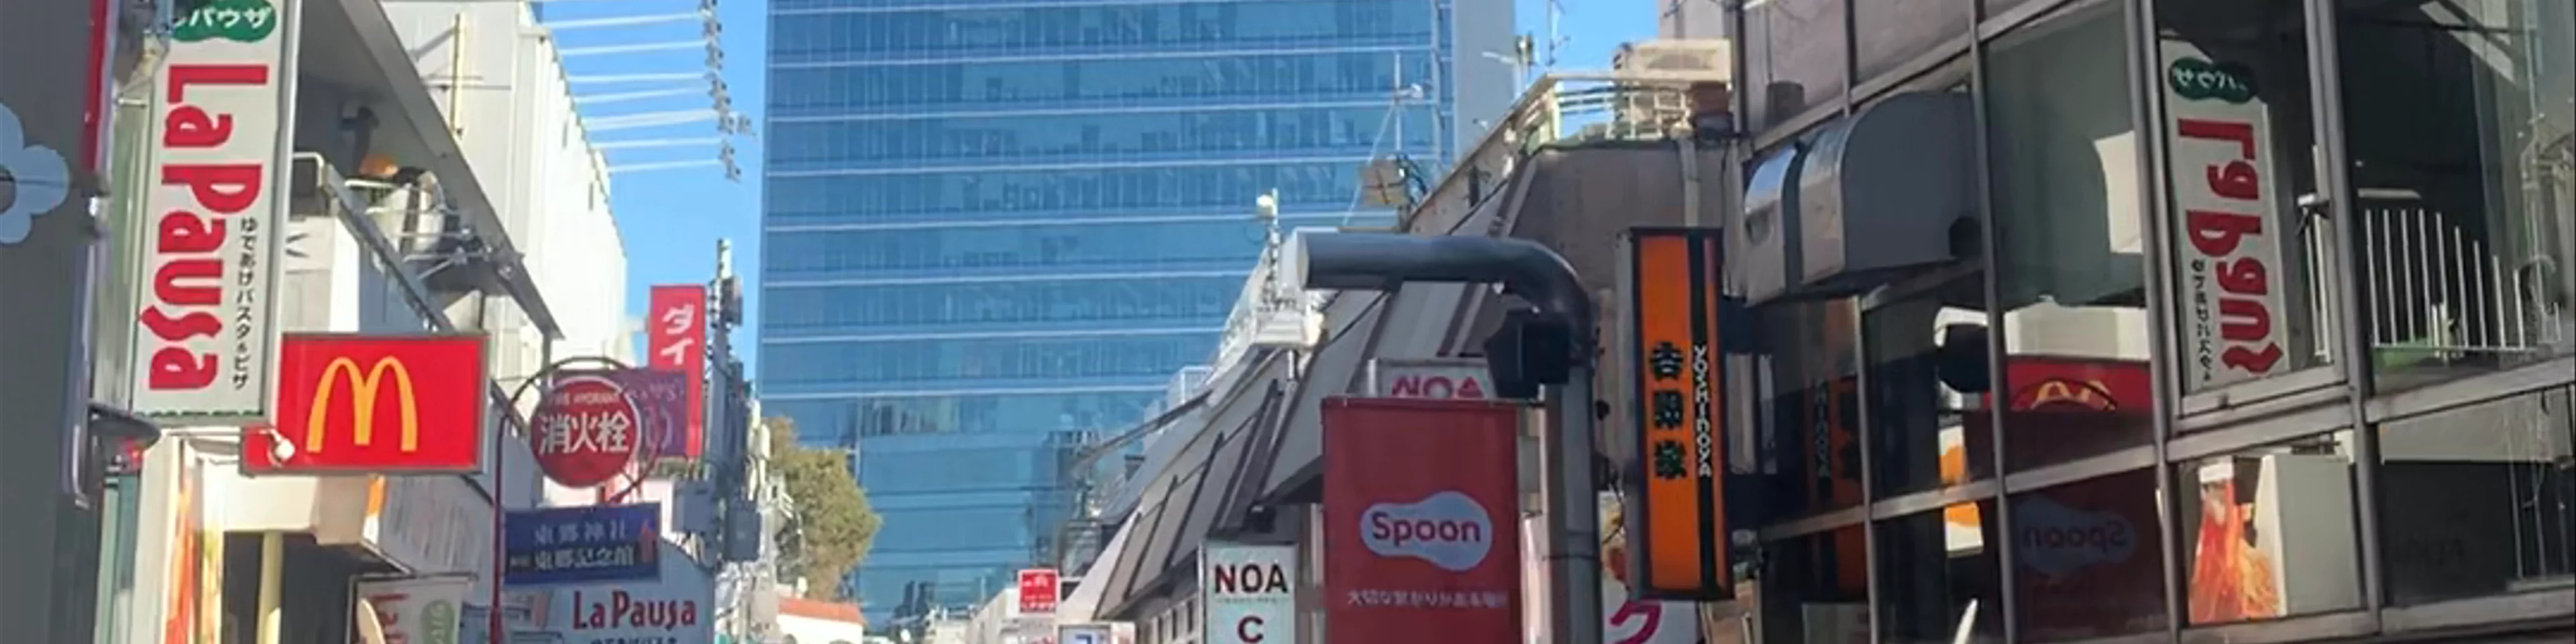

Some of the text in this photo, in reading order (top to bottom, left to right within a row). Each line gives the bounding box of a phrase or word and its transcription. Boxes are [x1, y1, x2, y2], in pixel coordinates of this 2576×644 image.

[174, 7, 272, 29] パウザ
[539, 411, 631, 456] 消火栓
[1372, 510, 1481, 549] Spoon
[1214, 564, 1289, 593] NOA
